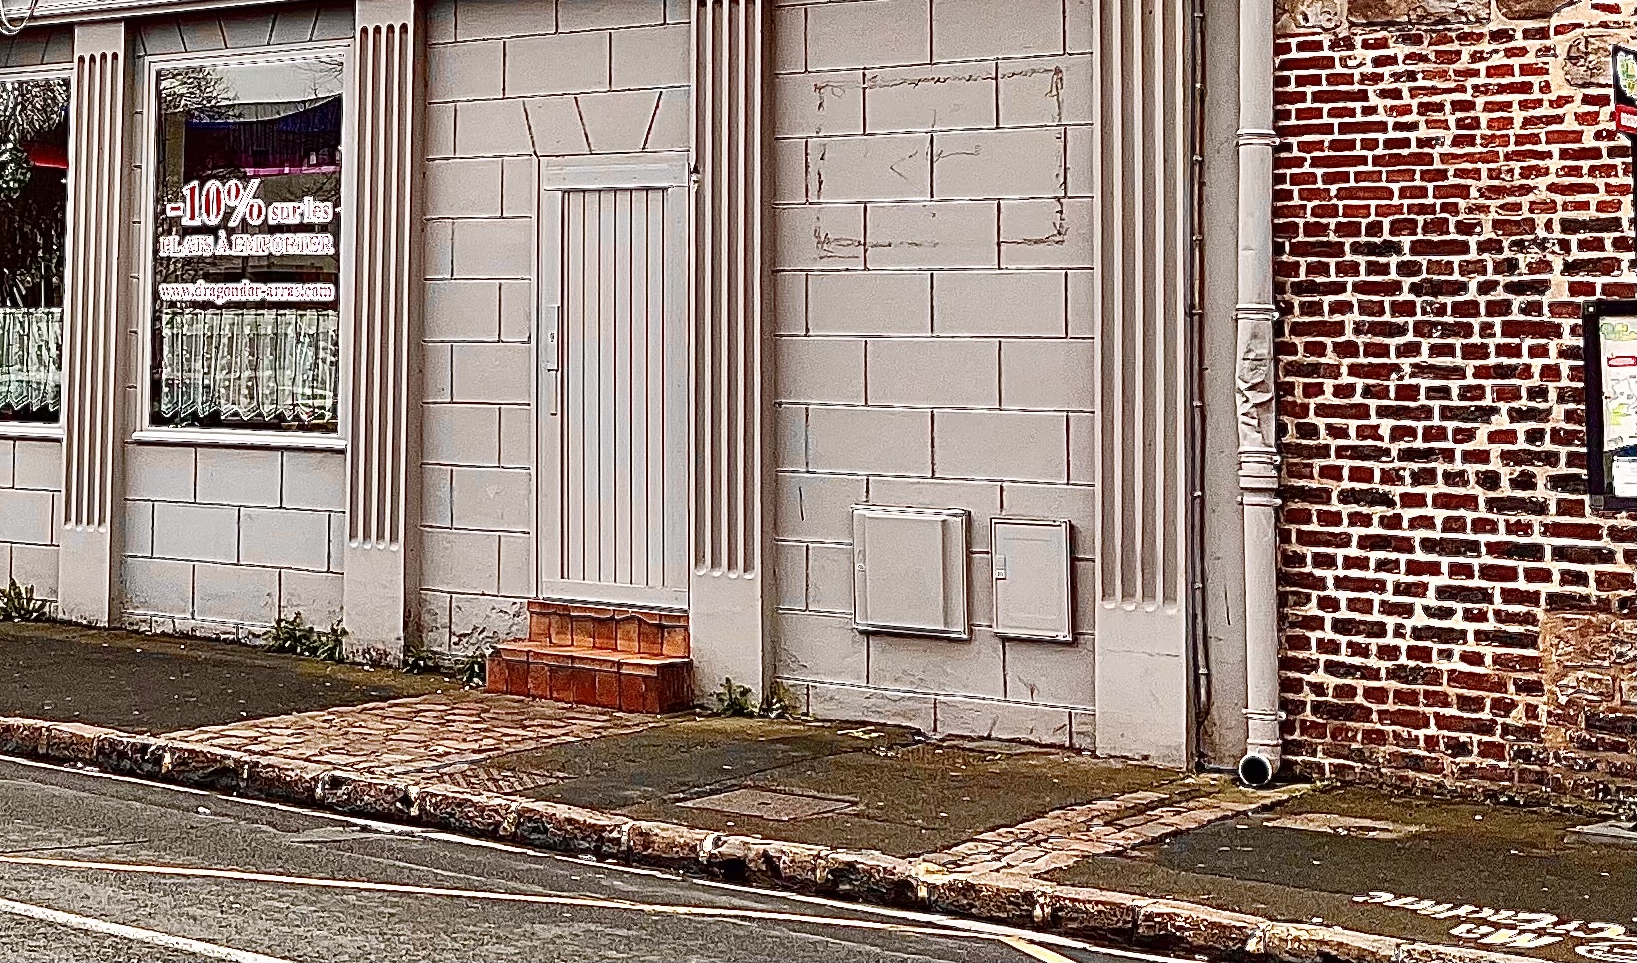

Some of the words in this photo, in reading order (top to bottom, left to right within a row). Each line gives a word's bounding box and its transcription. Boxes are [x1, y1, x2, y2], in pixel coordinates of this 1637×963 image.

[167, 178, 265, 227] -10%
[270, 203, 302, 223] sur
[302, 196, 333, 223] les
[159, 235, 214, 255] PLATS
[232, 234, 334, 254] EMPORTER
[160, 281, 334, 303] www.dragondor-arras.com
